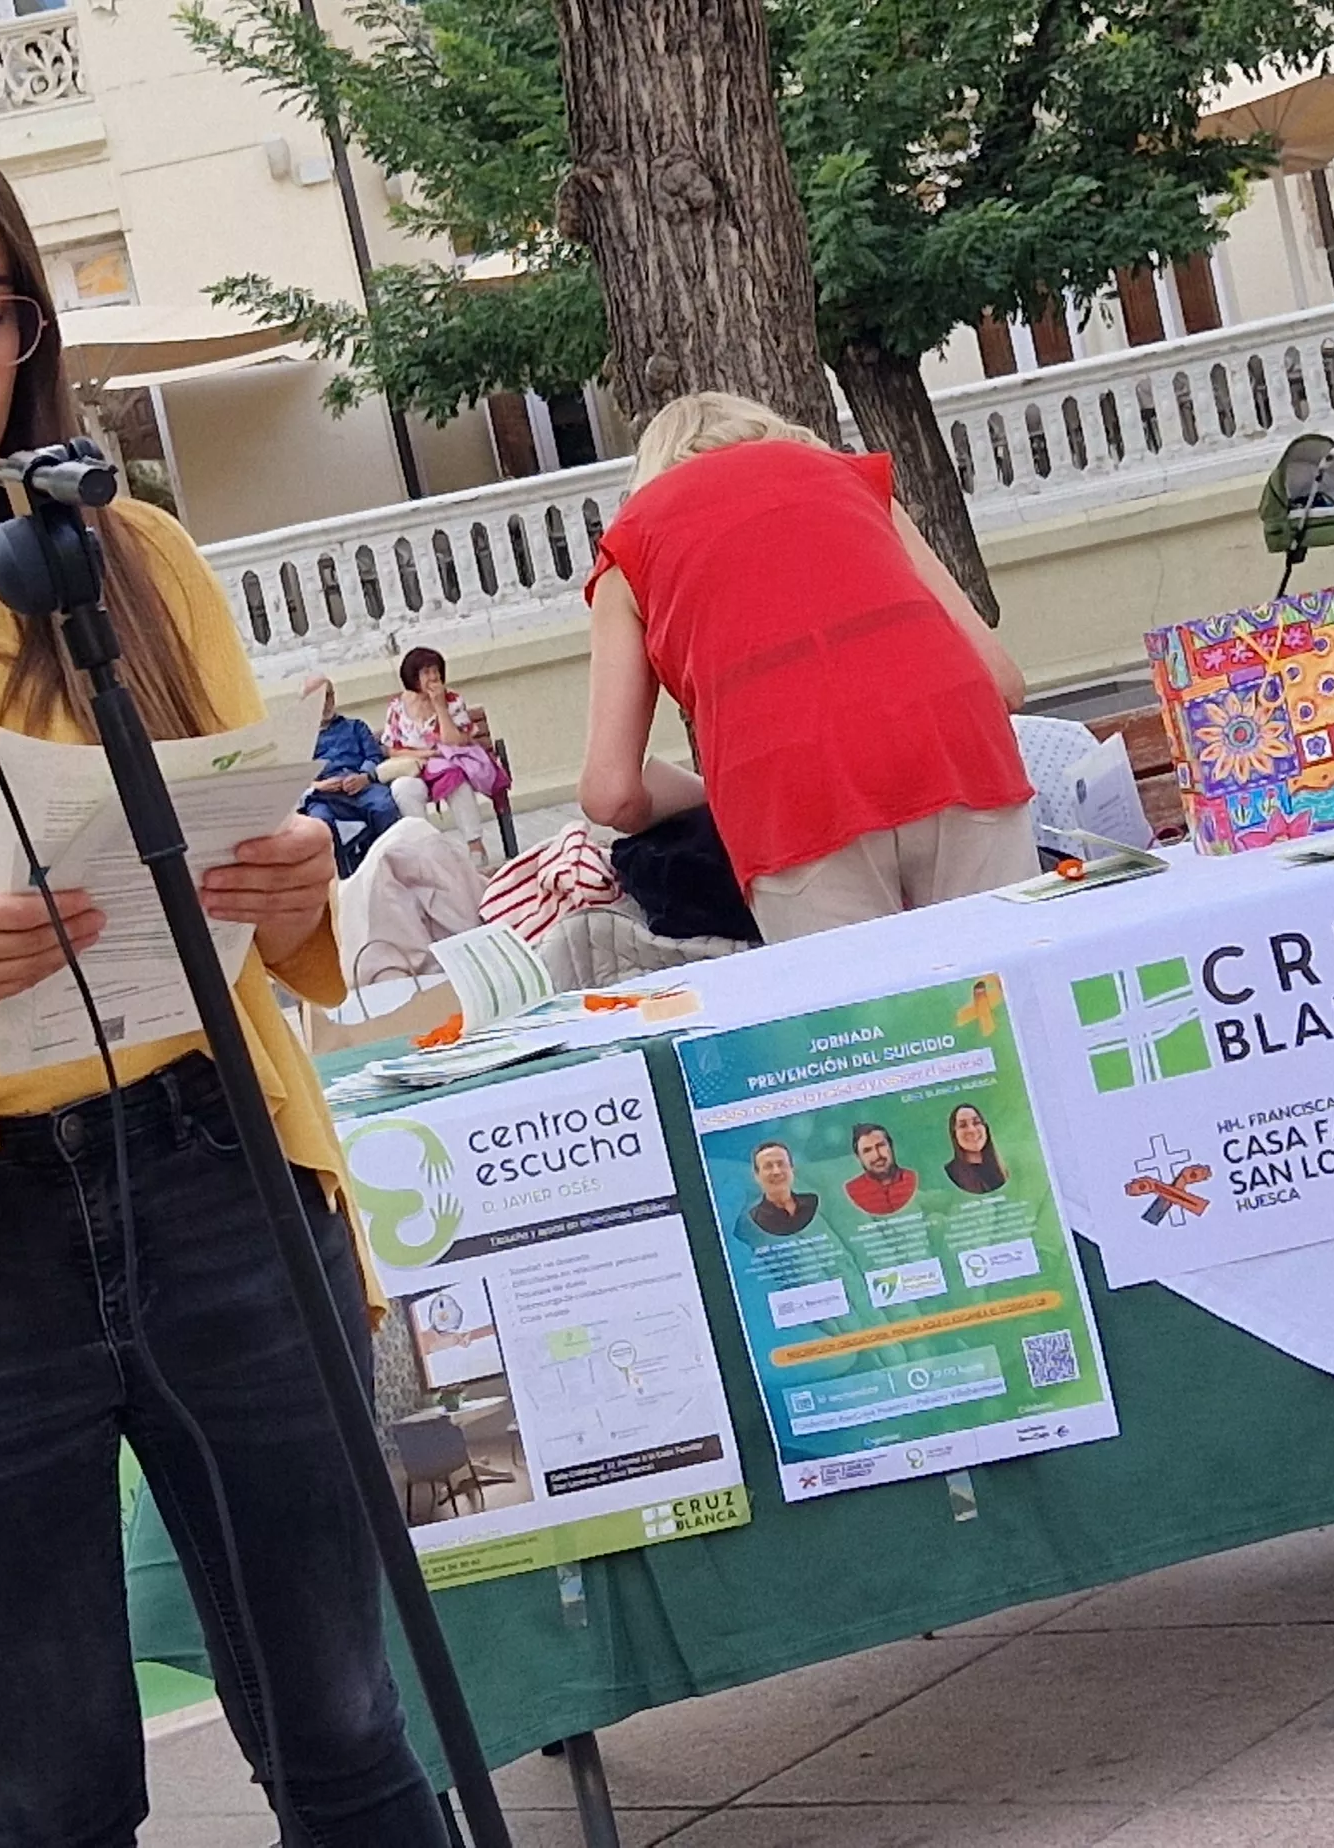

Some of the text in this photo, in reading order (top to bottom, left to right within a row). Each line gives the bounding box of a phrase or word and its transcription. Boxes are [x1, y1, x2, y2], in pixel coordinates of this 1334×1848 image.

[809, 1025, 885, 1054] JORNADA
[747, 1034, 956, 1092] PREVENCIÓN DEL SUICIDIO
[468, 1095, 644, 1155] centro de
[475, 1130, 643, 1188] escucha
[1222, 1126, 1306, 1165] CASA
[502, 1190, 554, 1211] JAVIER
[558, 1175, 603, 1199] OSÉS
[1229, 1158, 1293, 1197] SAN
[1236, 1187, 1302, 1213] HUESCA
[672, 1491, 736, 1518] CRUZ
[676, 1509, 739, 1532] BLANCA
